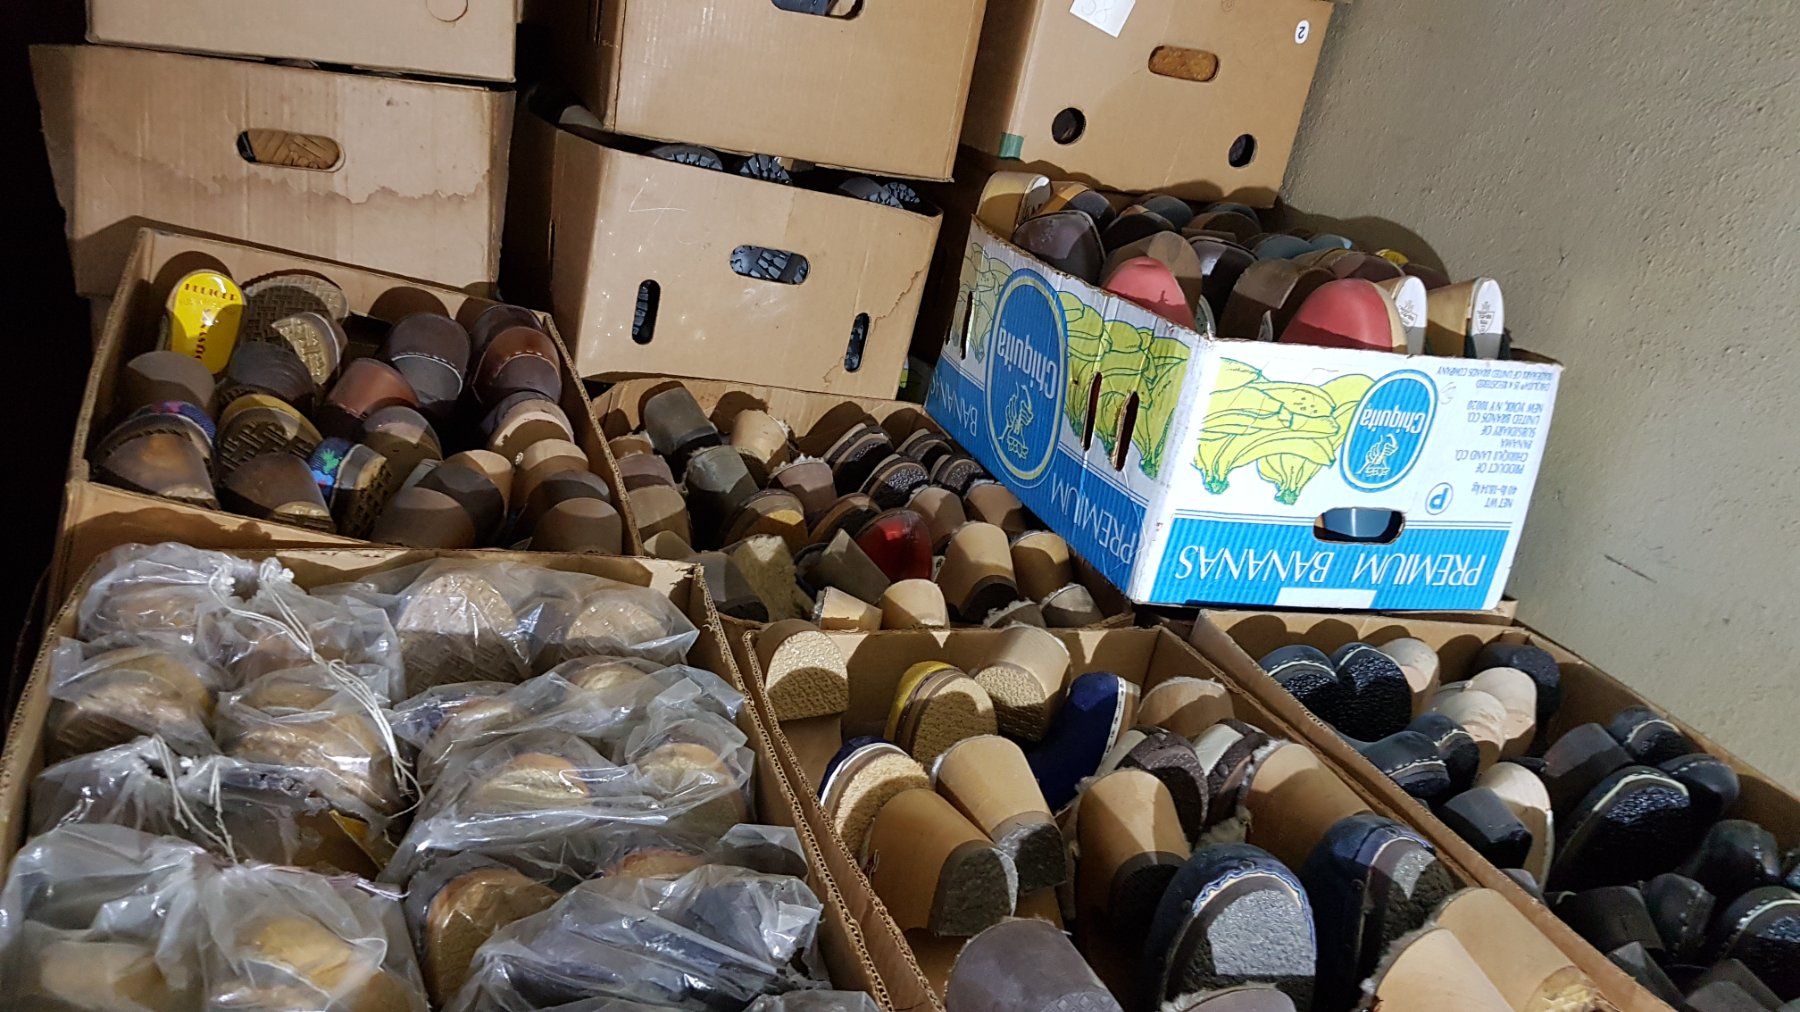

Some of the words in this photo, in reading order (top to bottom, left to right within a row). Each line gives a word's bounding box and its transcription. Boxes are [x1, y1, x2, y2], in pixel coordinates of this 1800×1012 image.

[1297, 25, 1306, 39] 2
[996, 324, 1058, 400] Chiquita
[1359, 404, 1426, 434] Chiquita
[1480, 413, 1511, 423] BRANDS
[1512, 413, 1540, 423] UNITED
[1480, 425, 1493, 436] OF
[1469, 450, 1493, 461] LAND
[1475, 462, 1488, 474] OF
[1487, 463, 1525, 475] PRODUCT
[1429, 487, 1450, 510] P
[1484, 497, 1498, 508] WT
[1498, 497, 1514, 509] NET
[1050, 472, 1137, 565] PREMIUM
[1175, 545, 1335, 583] BANANAS
[1350, 553, 1487, 587] PREMIUM
